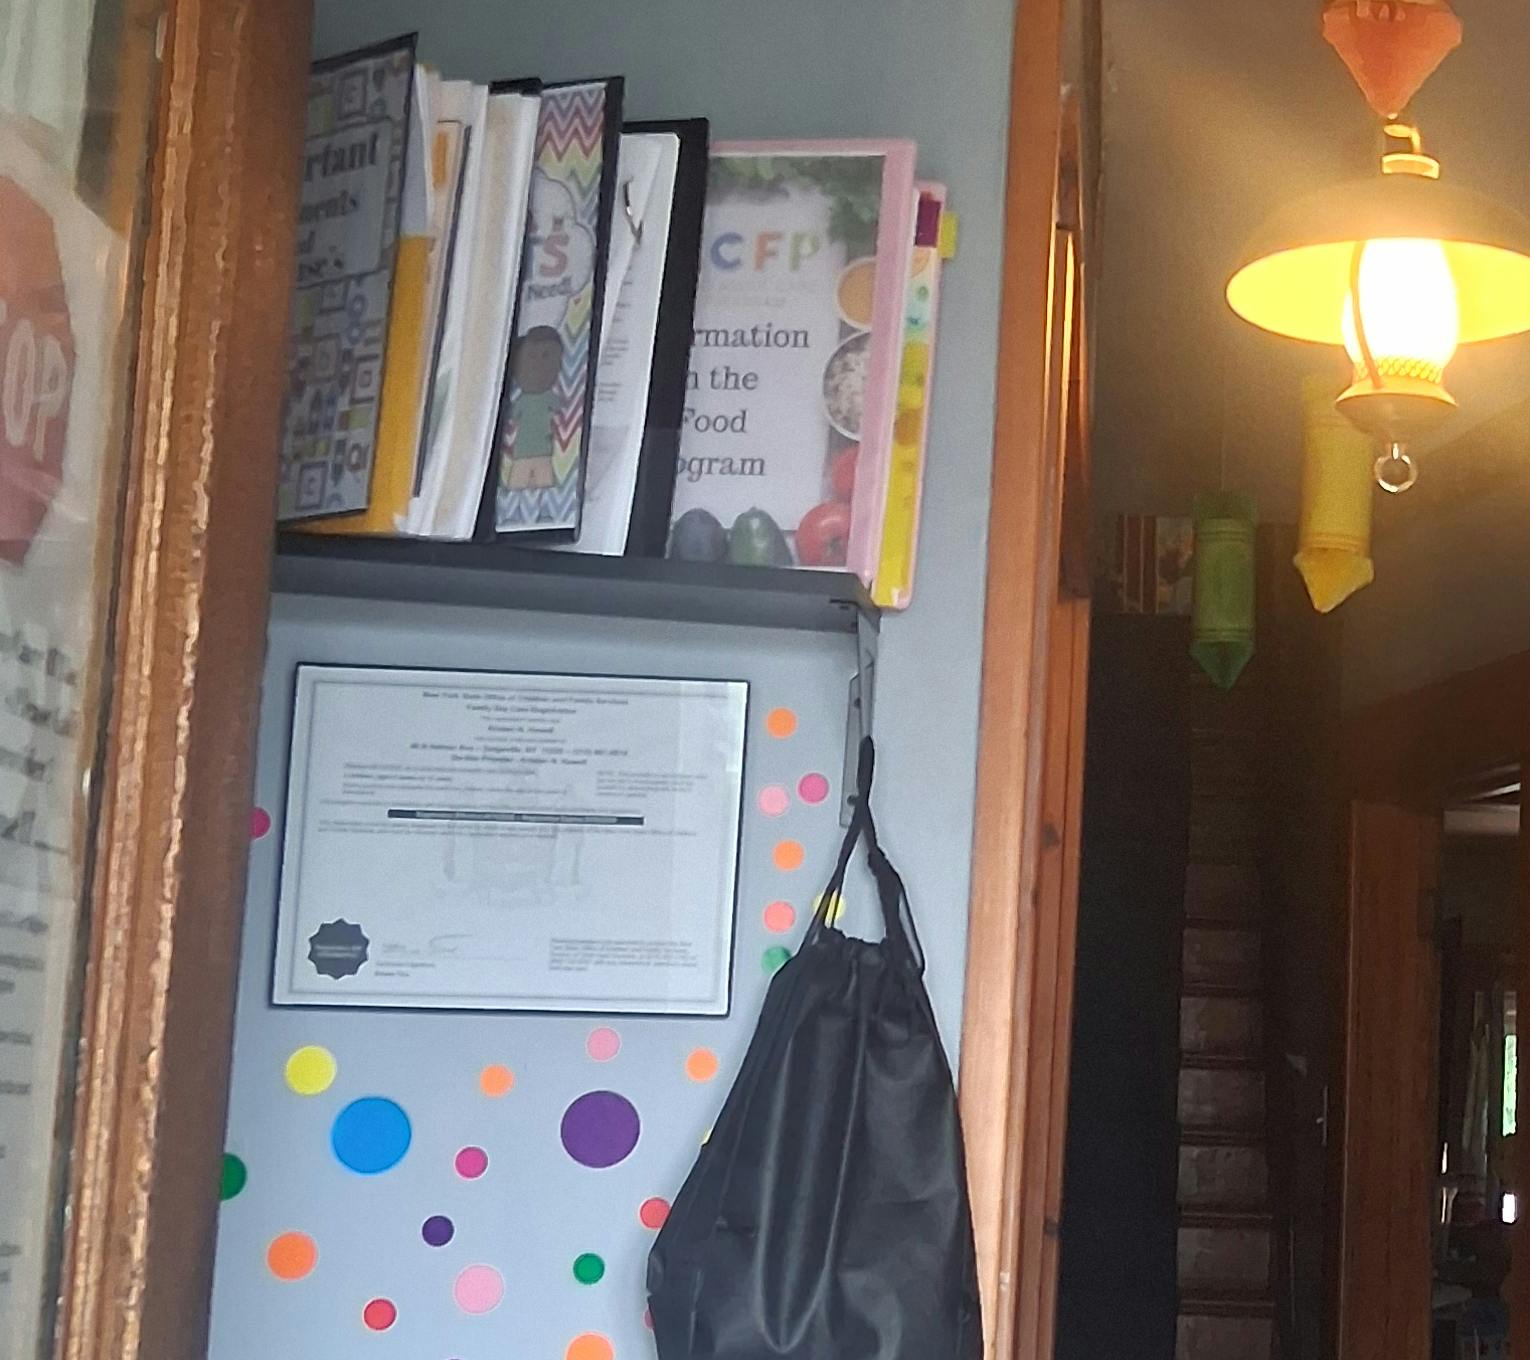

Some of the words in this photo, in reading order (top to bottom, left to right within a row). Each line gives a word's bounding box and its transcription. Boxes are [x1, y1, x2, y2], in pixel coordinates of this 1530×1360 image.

[710, 231, 820, 272] CFP
[0, 297, 68, 465] OP
[710, 366, 759, 391] the
